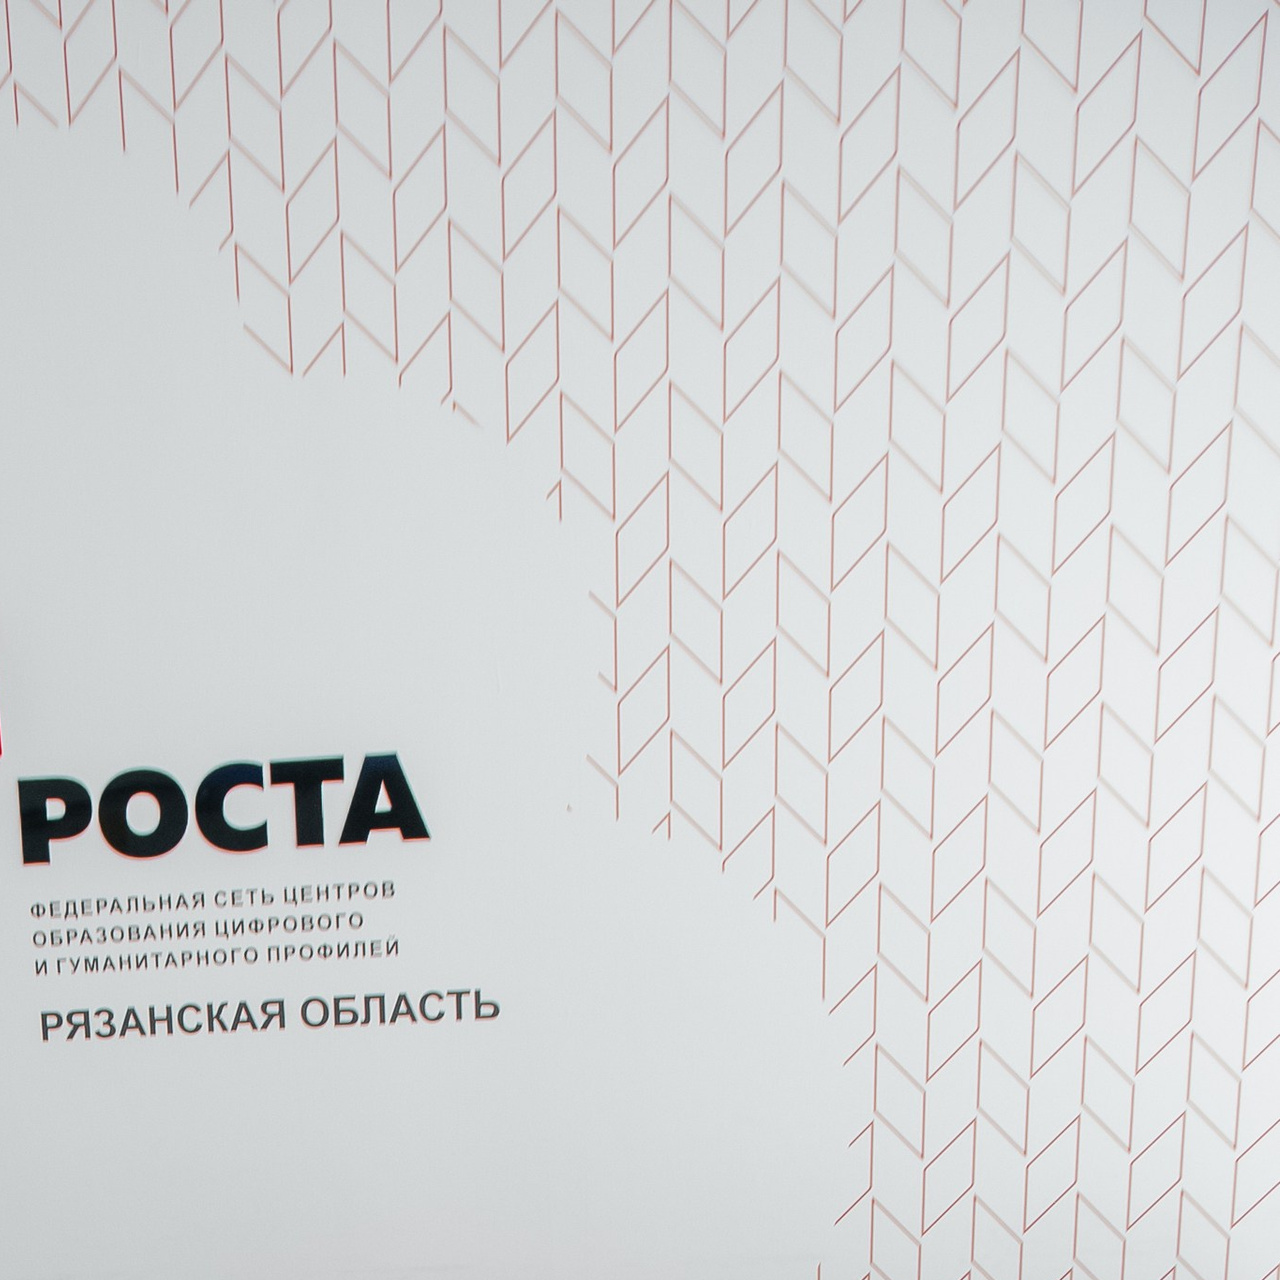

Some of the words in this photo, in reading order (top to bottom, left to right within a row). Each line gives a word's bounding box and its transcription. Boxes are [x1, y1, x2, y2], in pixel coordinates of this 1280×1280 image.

[17, 751, 432, 866] РОСТА
[29, 892, 207, 921] ФЕДЕРАЛЬНАЯ
[213, 887, 276, 907] СЕТЬ
[282, 880, 398, 906] ЦЕНТРОВ
[32, 920, 207, 948] ОБРАЗОВАНИЯ
[213, 911, 365, 939] ЦИФРОВОГО
[34, 959, 49, 977] И
[55, 946, 260, 977] ГУМАНИТАРНОГО
[266, 934, 401, 964] ПРОФИЛЕЙ
[39, 999, 287, 1042] РЯЗАНСКАЯ
[299, 988, 502, 1028] ОБЛАСТЬ
